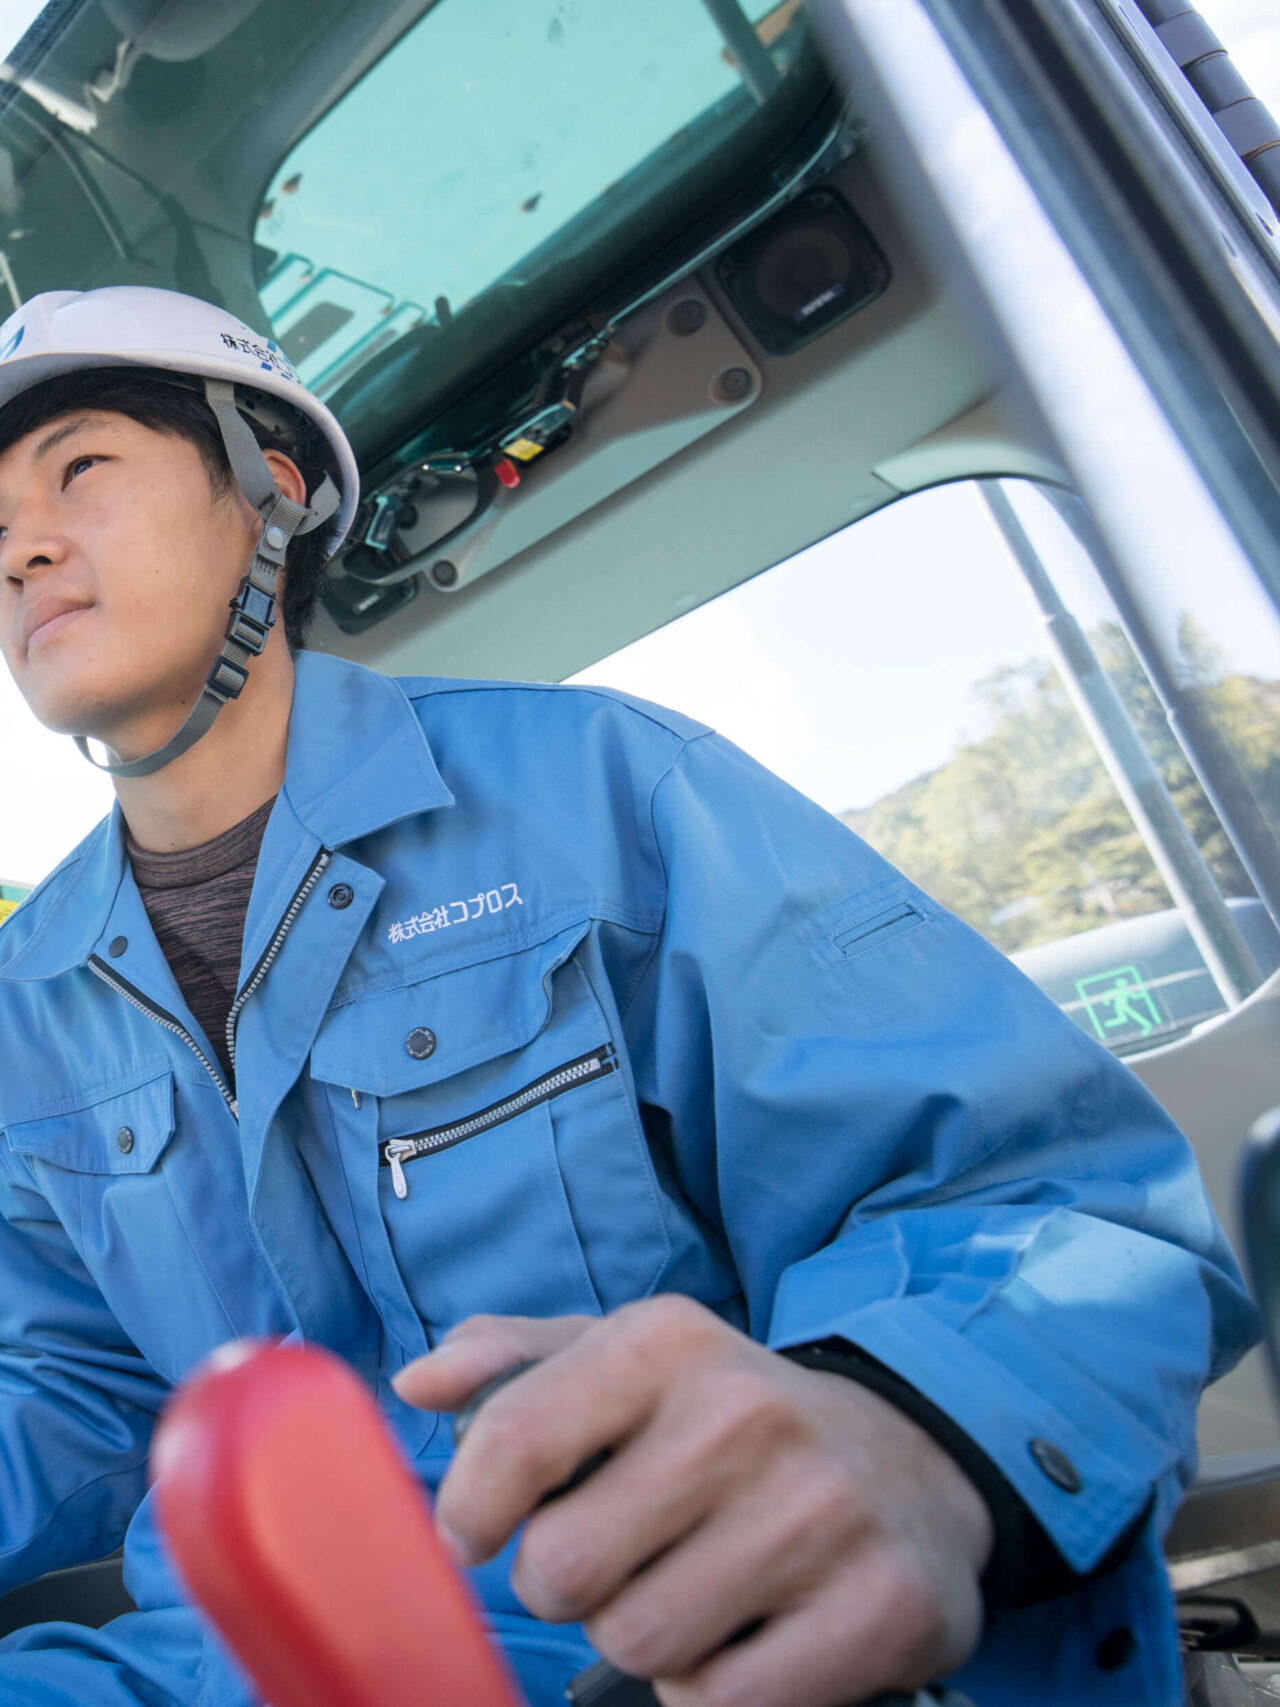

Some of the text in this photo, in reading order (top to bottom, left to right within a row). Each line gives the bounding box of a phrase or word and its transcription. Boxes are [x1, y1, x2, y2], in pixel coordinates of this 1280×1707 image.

[388, 882, 524, 944] 株式会社コプロス
